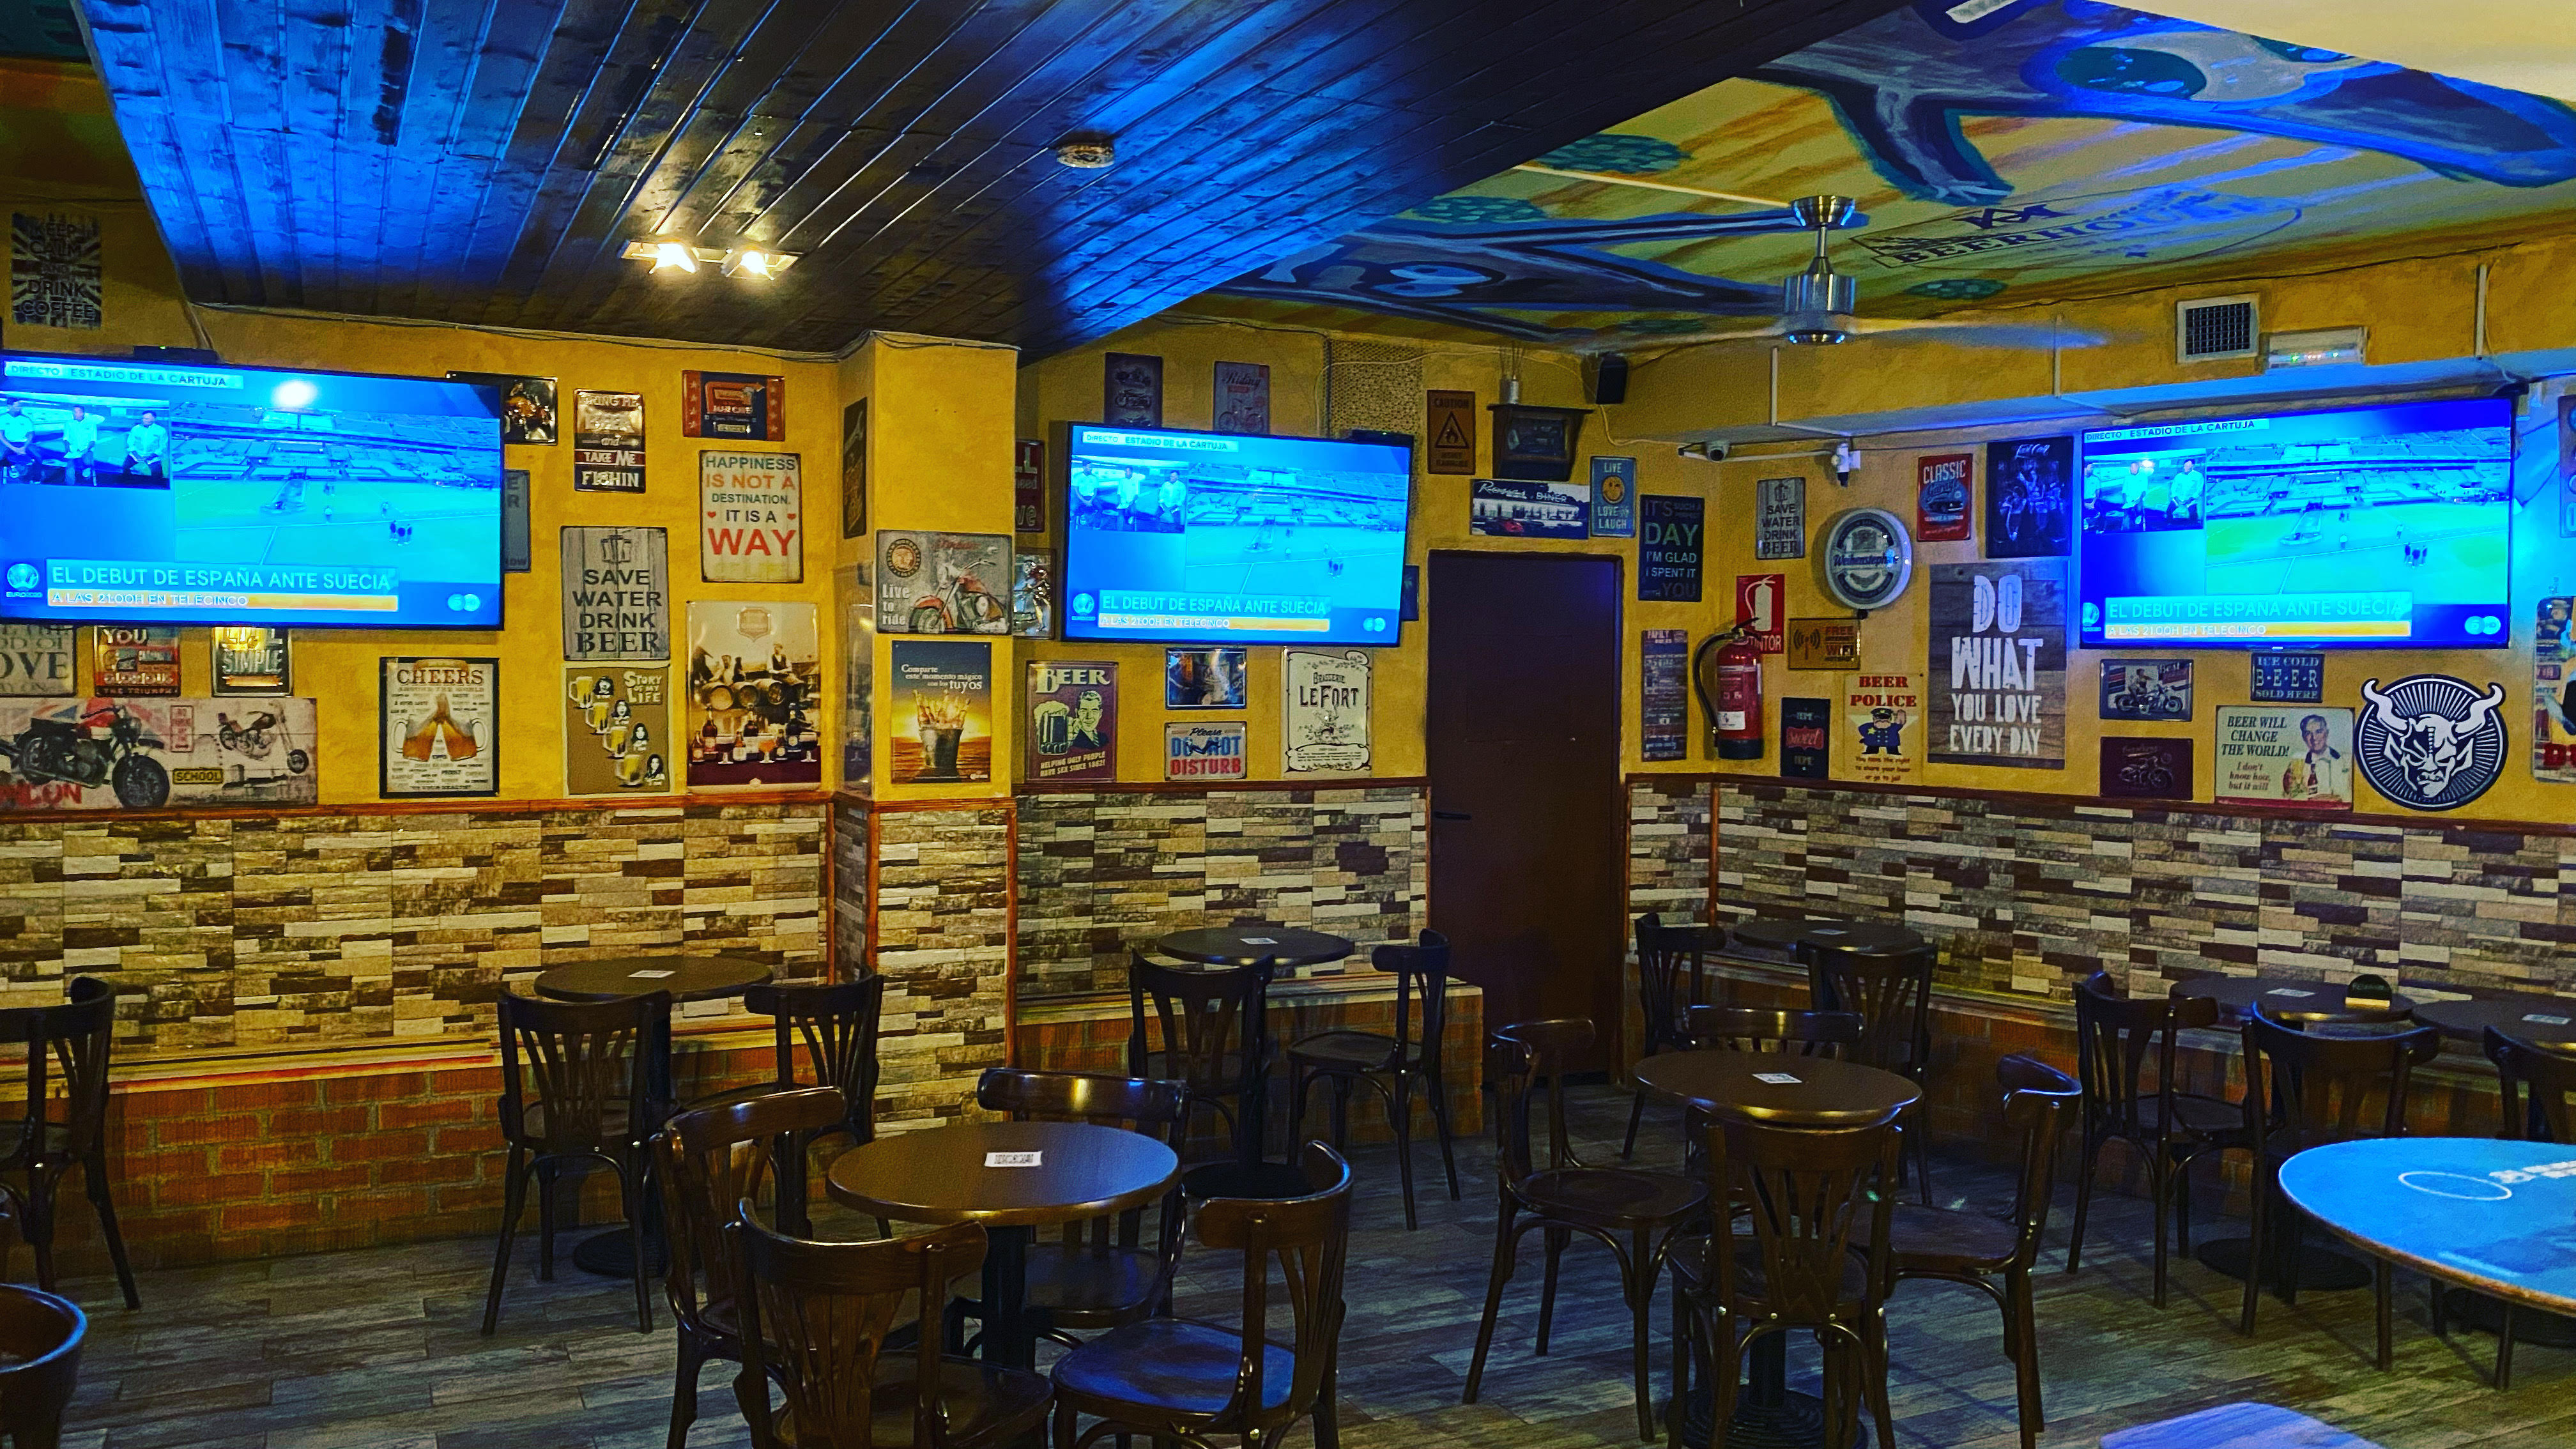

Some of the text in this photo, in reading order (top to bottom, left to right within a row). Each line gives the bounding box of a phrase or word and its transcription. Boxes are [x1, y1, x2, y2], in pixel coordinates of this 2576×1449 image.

[28, 280, 86, 296] DRINK
[21, 300, 95, 320] COFFEE
[12, 365, 227, 386] DIRECTO ESTADIO DE LA CARTUJA
[1434, 398, 1469, 409] CAUTION
[2087, 420, 2255, 440] DIRECTO ESTADIO DE LA CARTUJA
[1087, 434, 1118, 443] DIRECTO
[1125, 436, 1161, 446] ESTADIO
[1190, 441, 1227, 450] CARTUJA
[584, 450, 636, 466] TAKE ME
[705, 456, 796, 471] HAPPINESS
[1604, 463, 1621, 473] LIVE
[1922, 459, 1966, 485] CLASSIC
[705, 474, 796, 490] IS NOT A
[726, 509, 777, 523] IT IS A
[1644, 500, 1673, 517] IT'S
[1766, 503, 1796, 515] SAVE
[1598, 518, 1627, 530] LAUGH
[1761, 516, 1800, 528] WATER
[707, 528, 797, 556] WAY
[1644, 522, 1699, 547] DAY
[1763, 530, 1798, 541] DRINK
[1762, 541, 1800, 554] BEER
[1646, 551, 1697, 564] I'M GLAD
[52, 567, 391, 590] EL DEBUT DE ESPAÑA ANTE SUECIA
[583, 569, 650, 585] SAVE
[1651, 567, 1685, 578] SPENT
[1686, 568, 1696, 578] IT
[882, 584, 910, 599] Live
[1662, 582, 1696, 598] YOU
[52, 593, 249, 606] A LAS EN TELECINCO
[572, 590, 663, 607] WATER
[1102, 595, 1326, 615] EL DEBUT DE ESPAÑA ANTE SUECIA
[1972, 574, 2023, 633] DO
[882, 601, 894, 613] to
[2110, 599, 2400, 618] EL DEBUT DE ESPAÑA ANTE SUECIA
[579, 613, 656, 628] DRINK
[882, 614, 906, 625] ride
[1102, 617, 1109, 625] A
[1111, 617, 1130, 625] LAS
[1165, 618, 1176, 627] EN
[1179, 618, 1230, 628] TELECINCO
[102, 628, 148, 645] YOU
[1825, 626, 1853, 635] FREE
[2109, 627, 2116, 636] A
[2119, 626, 2139, 636] LAS
[2182, 625, 2197, 635] EN
[2200, 625, 2266, 635] TELECINCO
[575, 632, 662, 652] BEER
[222, 649, 282, 674] SIMPLE
[1951, 636, 2044, 691] WHAT
[2257, 657, 2319, 666] ICE COLD
[397, 669, 484, 685] CHEERS
[901, 664, 938, 675] Comparte
[624, 671, 663, 688] STORY
[949, 680, 983, 694] tuyos
[1036, 669, 1110, 693] BEER
[1859, 676, 1909, 688] BEER
[627, 688, 661, 703] LIFE
[1850, 694, 1917, 707] POLICE
[1951, 693, 2042, 723] YOU LOVE
[2227, 716, 2287, 728] BEER WILL
[1190, 727, 1222, 737] Please
[1950, 724, 2041, 755] EVERY DAY
[2231, 730, 2278, 742] CHANGE
[1206, 736, 1241, 756] NOT
[2221, 744, 2290, 757] THE WORLD!
[1170, 758, 1241, 776] DISTURB
[176, 772, 221, 782] SCHOOL
[2230, 771, 2250, 779] know
[2228, 781, 2242, 790] but
[2252, 782, 2269, 790] will
